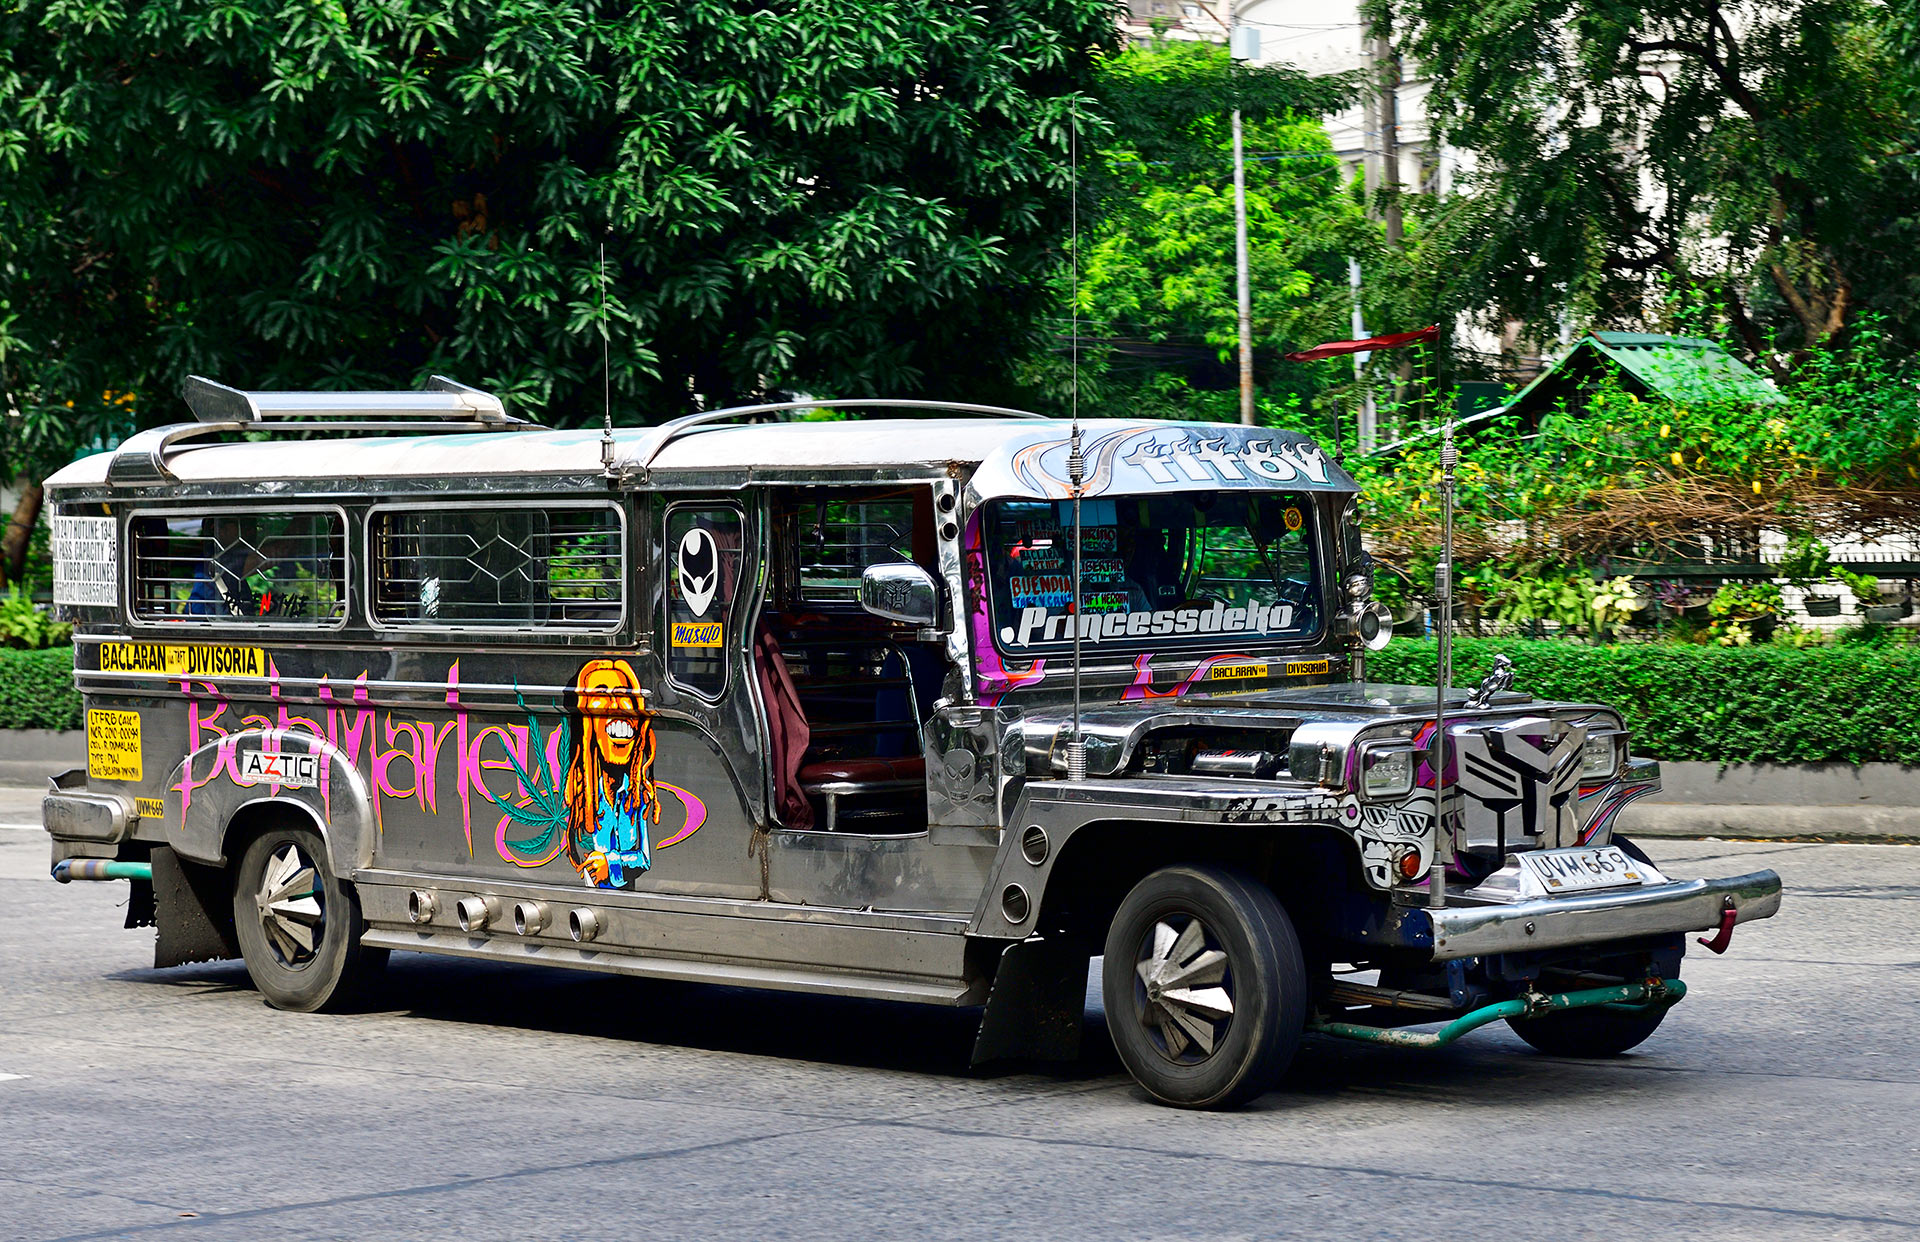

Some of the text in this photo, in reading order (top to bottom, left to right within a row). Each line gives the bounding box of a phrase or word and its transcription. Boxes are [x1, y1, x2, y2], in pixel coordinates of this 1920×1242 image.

[75, 541, 105, 562] CAPACITY
[109, 541, 117, 563] 25
[83, 562, 115, 583] HOTLINES
[1011, 576, 1073, 597] BUENDIA
[102, 644, 167, 671] BACLARAN
[188, 646, 258, 675] DIVISORIA
[1213, 667, 1259, 679] BACLARAN
[1287, 662, 1327, 674] DIVISORIA
[90, 711, 118, 726] LTFRB
[1530, 850, 1630, 878] UVM 669
